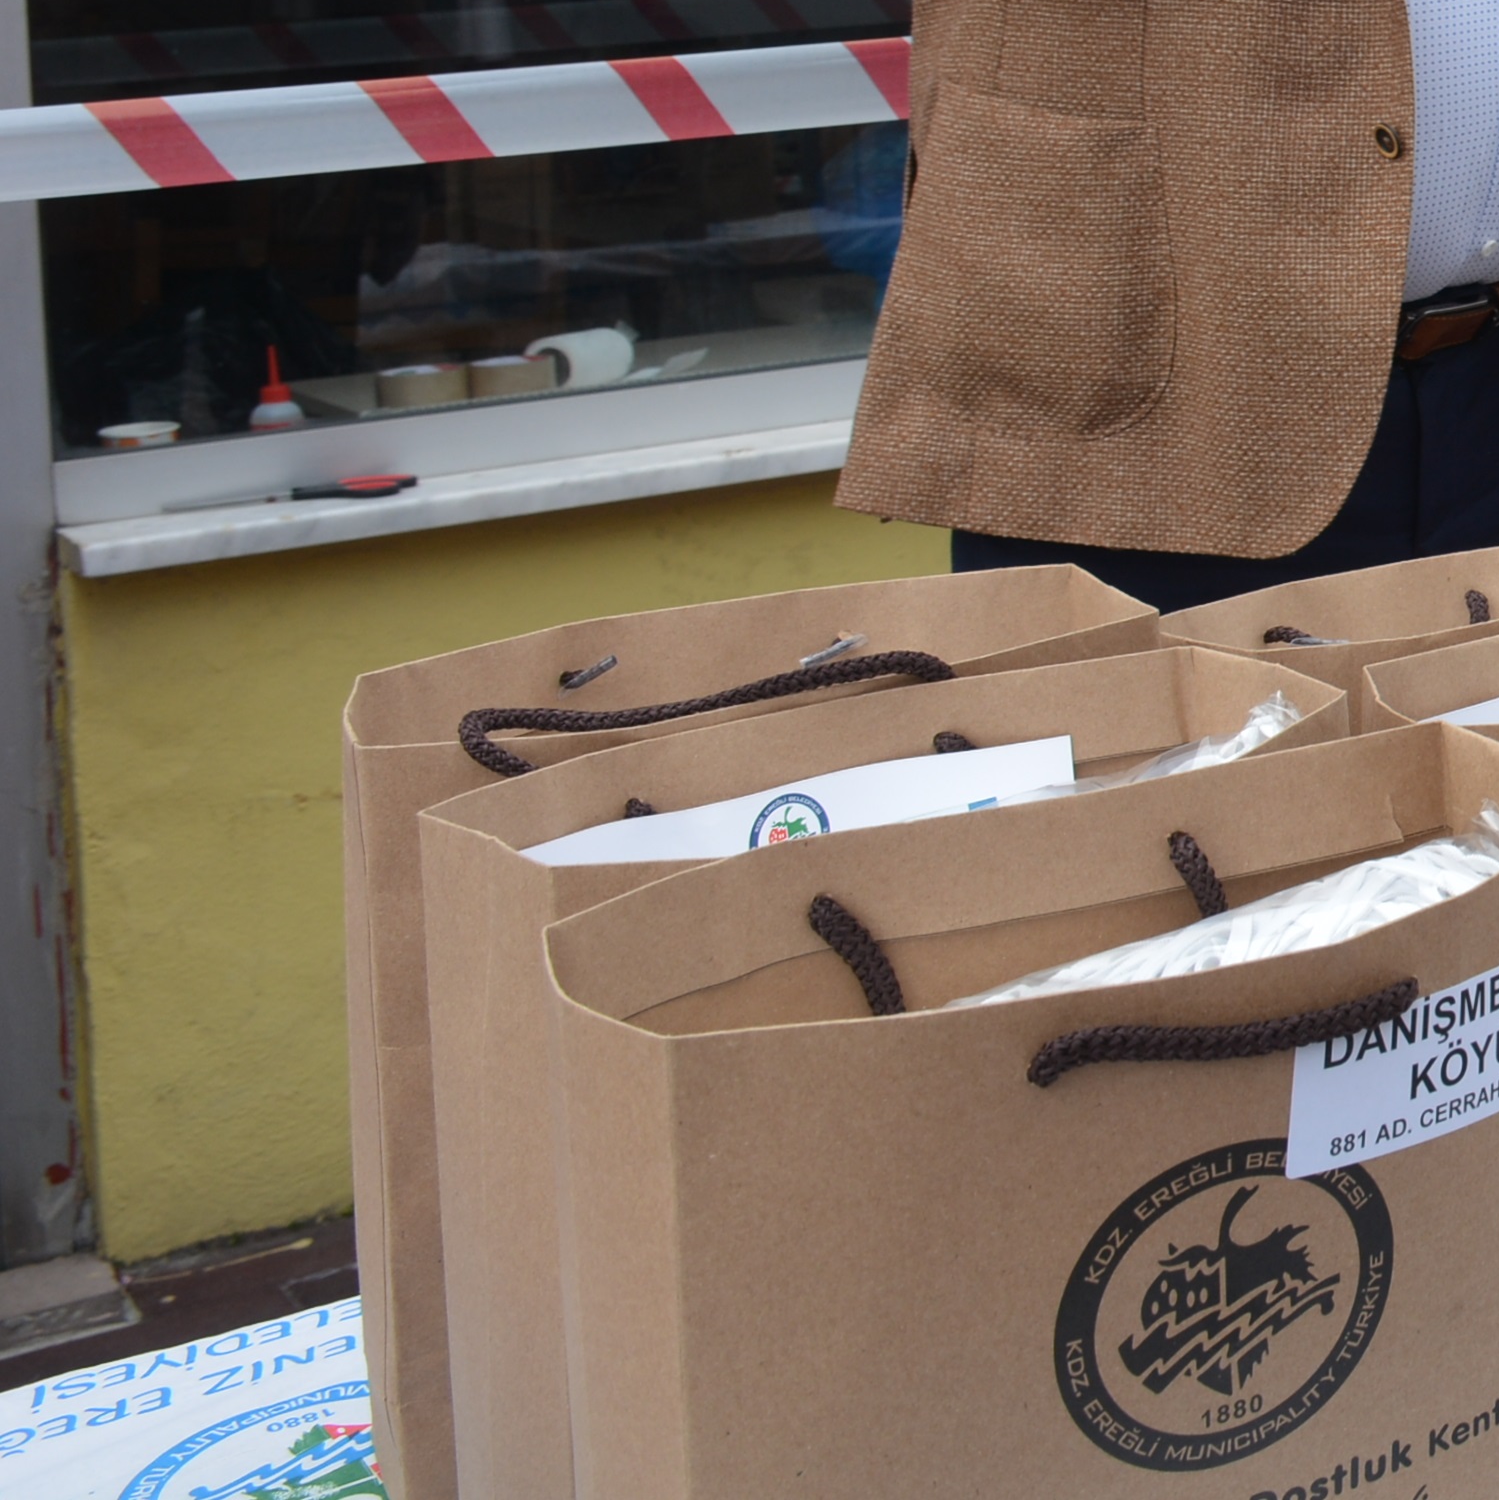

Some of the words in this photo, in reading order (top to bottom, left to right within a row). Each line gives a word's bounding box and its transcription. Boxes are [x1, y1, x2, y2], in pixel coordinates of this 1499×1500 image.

[1329, 1129, 1367, 1157] 881
[1375, 1117, 1413, 1146] AD.
[1083, 1226, 1134, 1285] KDZ.
[1132, 1152, 1234, 1223] EREĞLİ
[31, 1299, 363, 1415] ELEDİYESİ
[199, 1334, 357, 1397] ENİZ
[1065, 1338, 1091, 1398] KDZ.
[1083, 1397, 1160, 1458] EREĞLİ
[1164, 1367, 1337, 1462] MUNICIPALITY
[1336, 1250, 1385, 1363] TÜRKİYE
[0, 1386, 173, 1459] EREĞ
[265, 1408, 336, 1433] 1880
[1200, 1393, 1264, 1428] 1880
